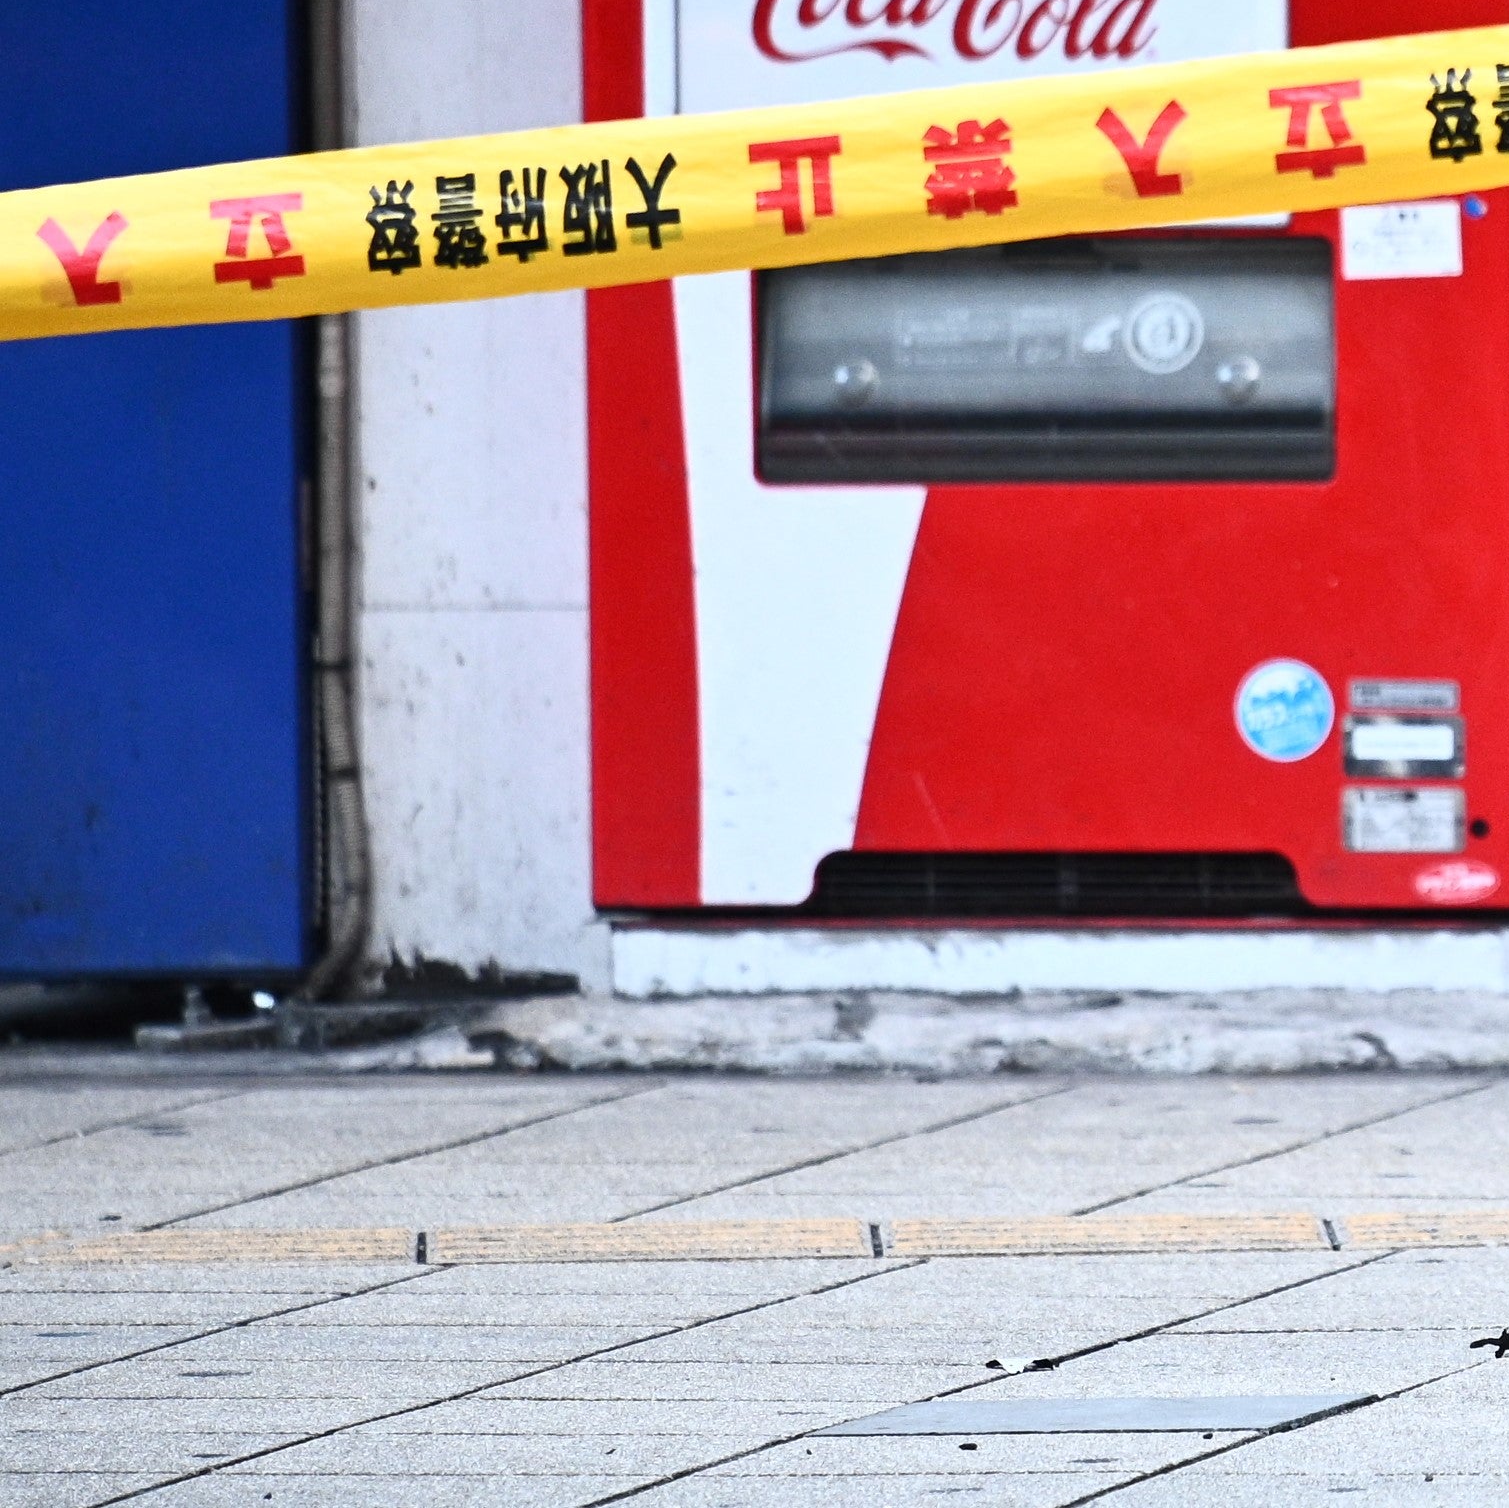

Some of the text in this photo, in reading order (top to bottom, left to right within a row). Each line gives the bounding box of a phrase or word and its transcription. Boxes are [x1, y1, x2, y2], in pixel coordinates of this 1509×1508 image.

[364, 151, 682, 276] 大阪府警察
[748, 79, 1367, 236] 立入禁止
